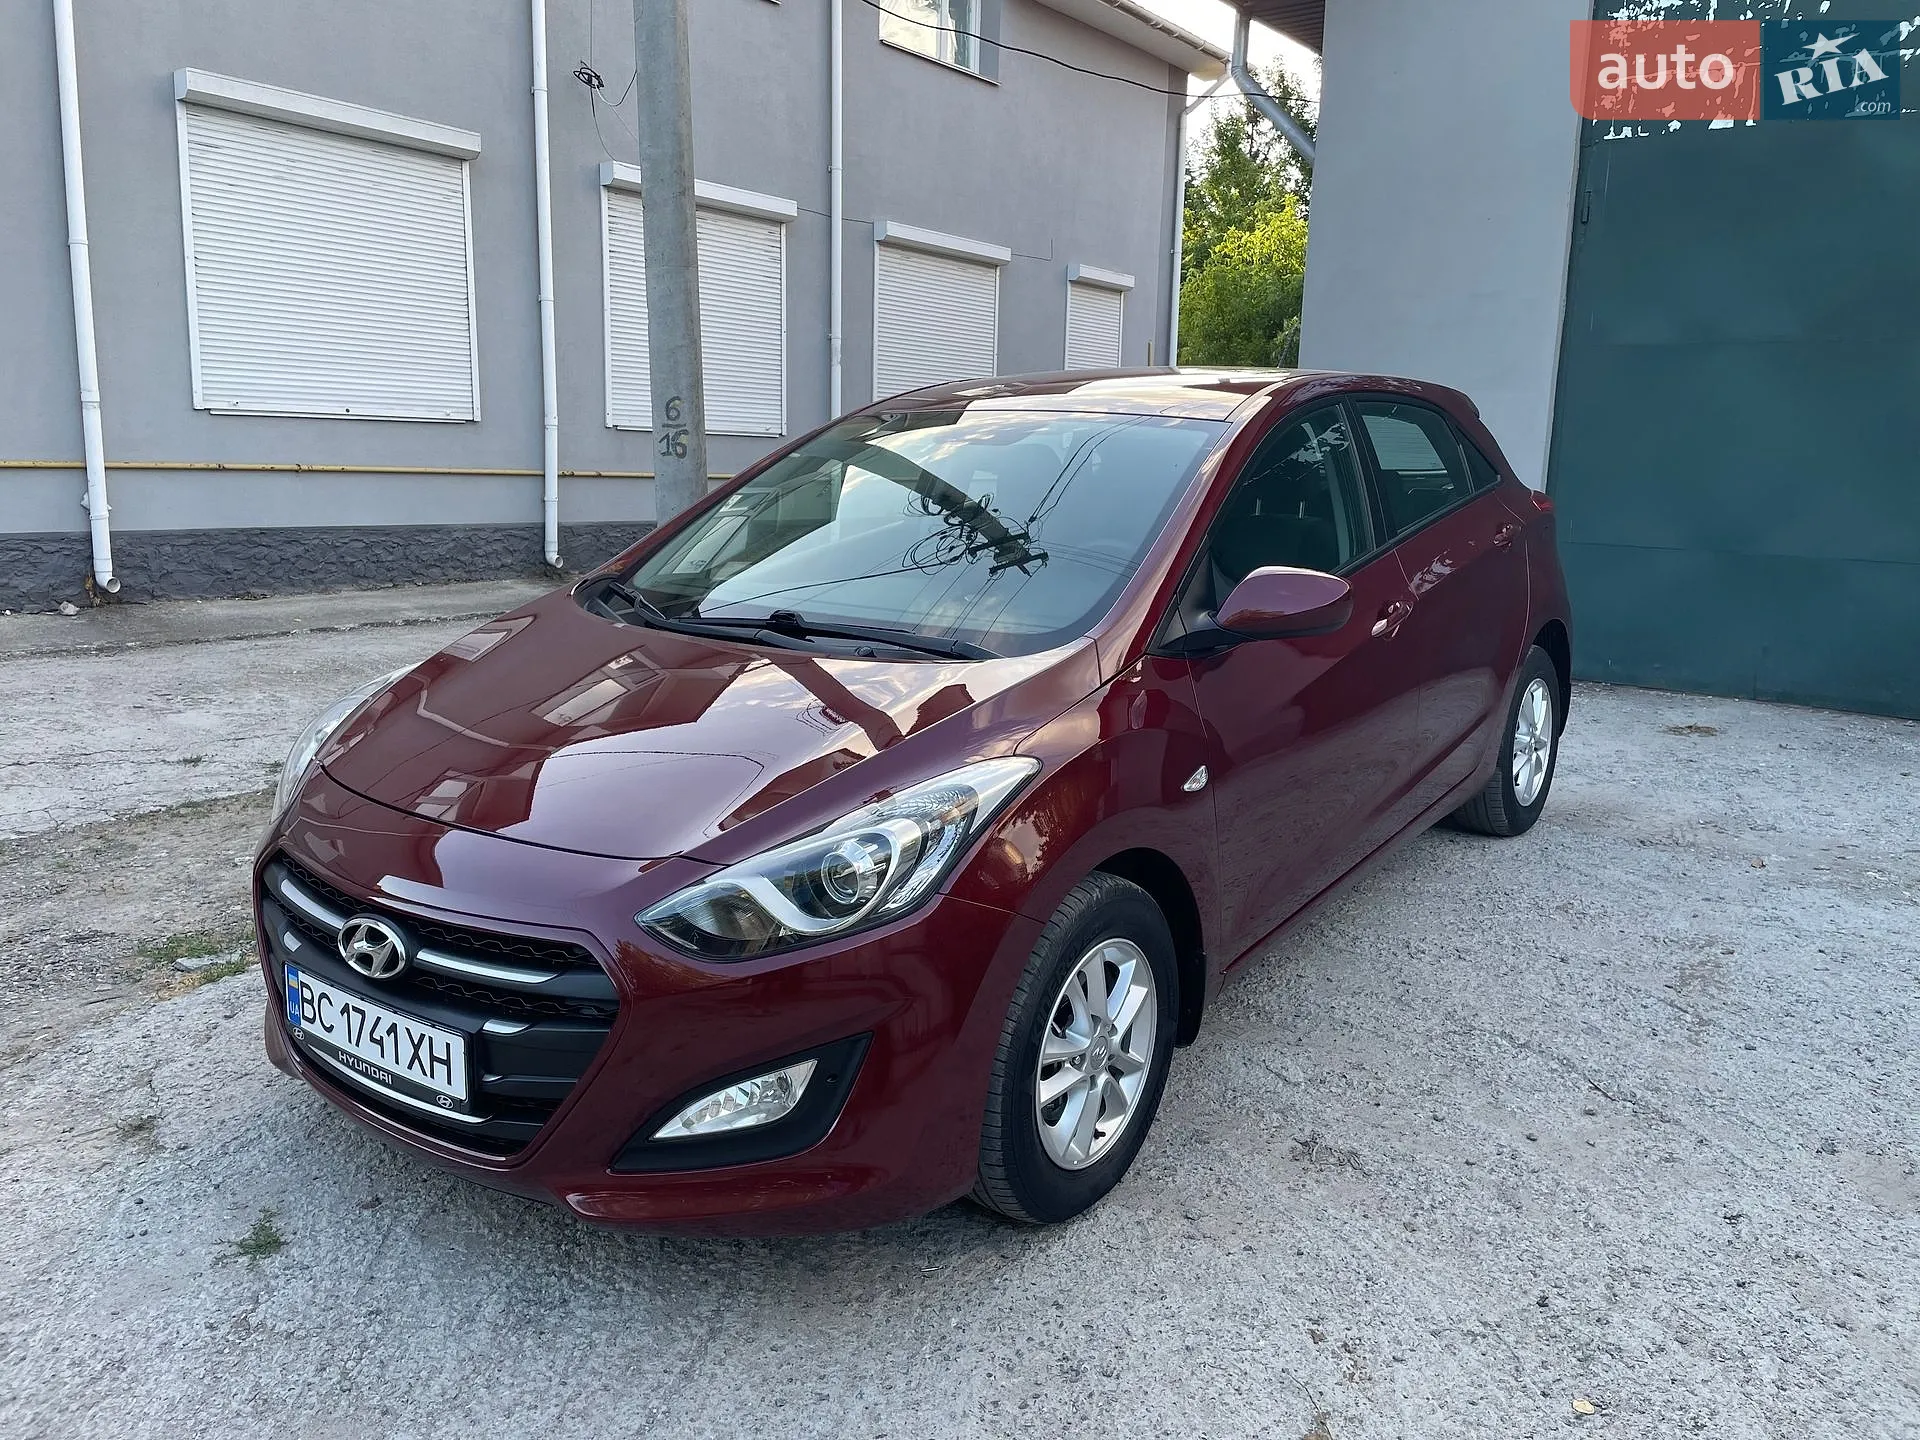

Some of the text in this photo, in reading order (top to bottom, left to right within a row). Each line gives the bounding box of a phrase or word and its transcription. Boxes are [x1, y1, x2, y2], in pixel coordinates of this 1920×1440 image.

[665, 396, 682, 421] 6
[290, 1000, 299, 1016] UA
[338, 1050, 393, 1085] HYUNDAI
